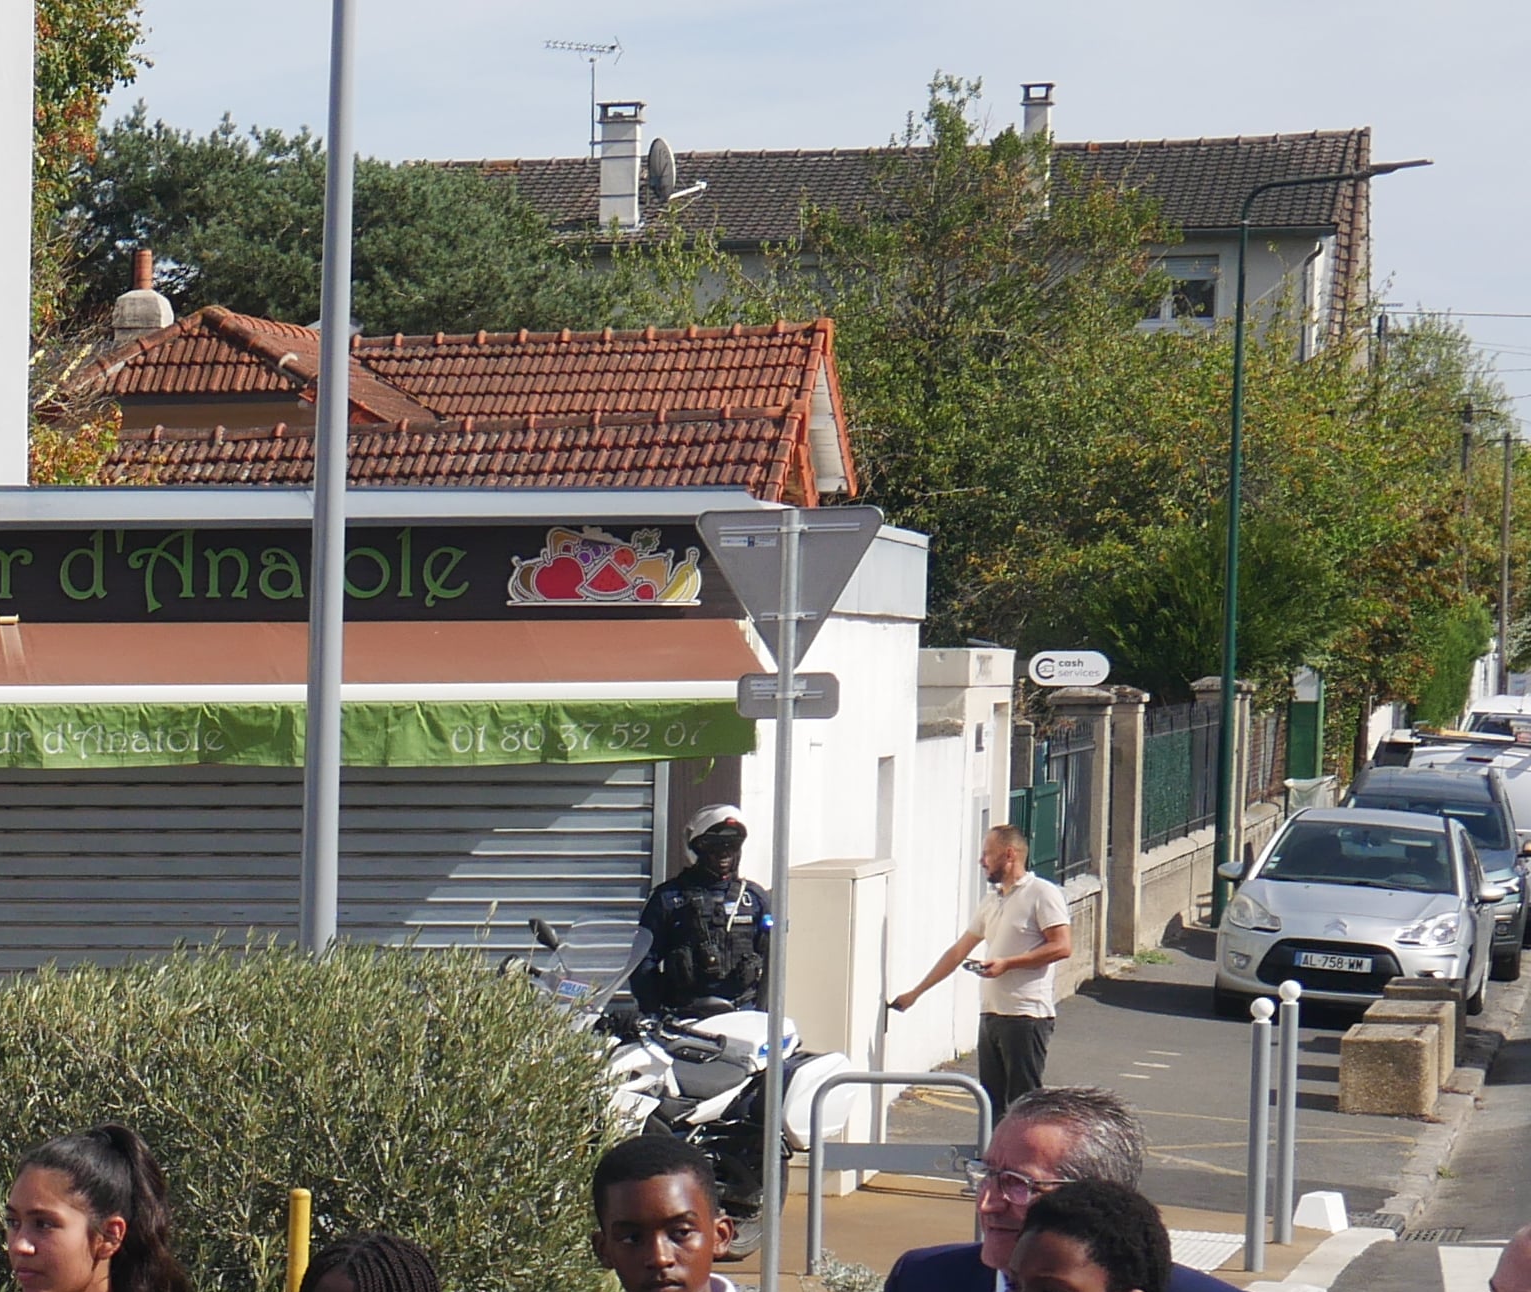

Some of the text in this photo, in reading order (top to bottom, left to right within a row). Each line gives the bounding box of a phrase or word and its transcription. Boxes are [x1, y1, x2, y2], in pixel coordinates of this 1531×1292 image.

[58, 526, 470, 614] d'Anaole
[1058, 658, 1084, 667] cash
[1058, 669, 1101, 678] services
[42, 721, 226, 760] d'Anatole
[451, 723, 488, 753] 01
[500, 721, 546, 752] 80
[557, 722, 602, 752] 37
[607, 721, 651, 750] 52
